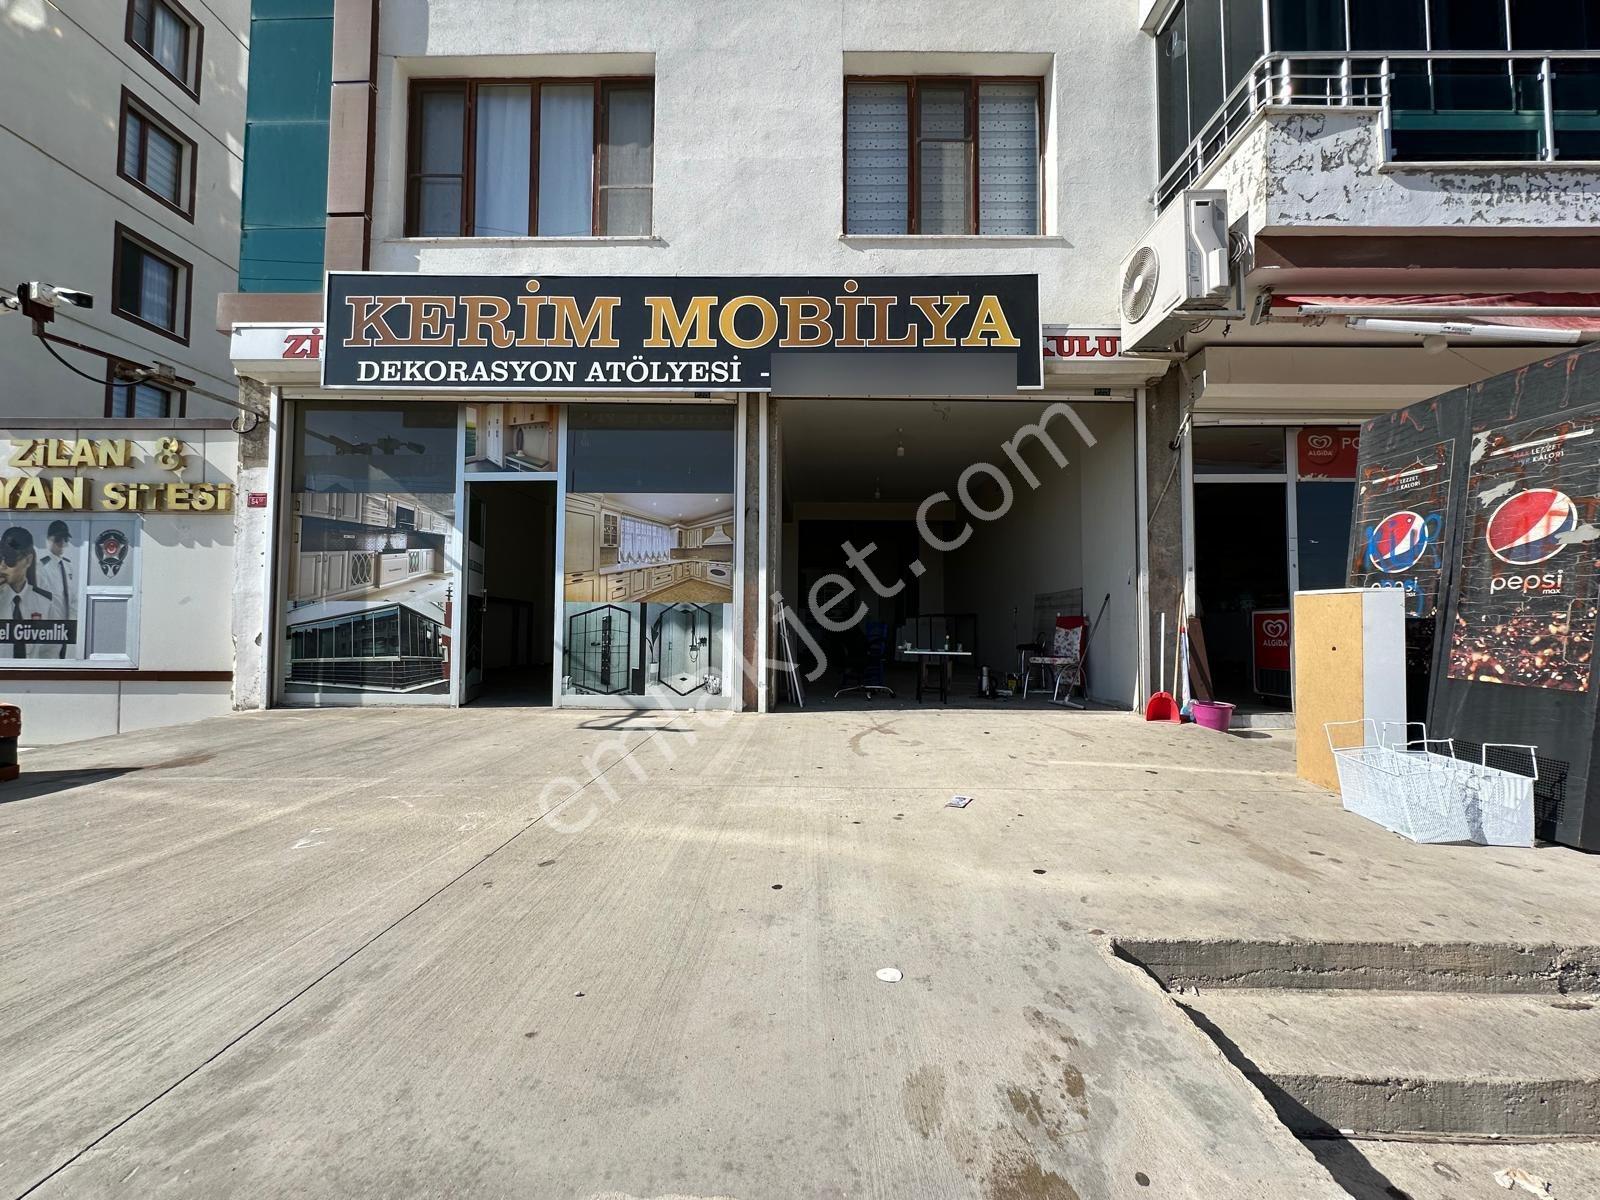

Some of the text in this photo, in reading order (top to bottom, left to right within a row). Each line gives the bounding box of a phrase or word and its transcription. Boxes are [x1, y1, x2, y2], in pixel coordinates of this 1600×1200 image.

[343, 279, 1021, 349] KERİM MOBİLYA
[357, 360, 577, 382] DEKORASYON
[585, 355, 742, 383] ATÖLYESİ
[155, 437, 182, 471] &
[1490, 570, 1563, 595] pepsi
[14, 624, 68, 640] Güvenlik
